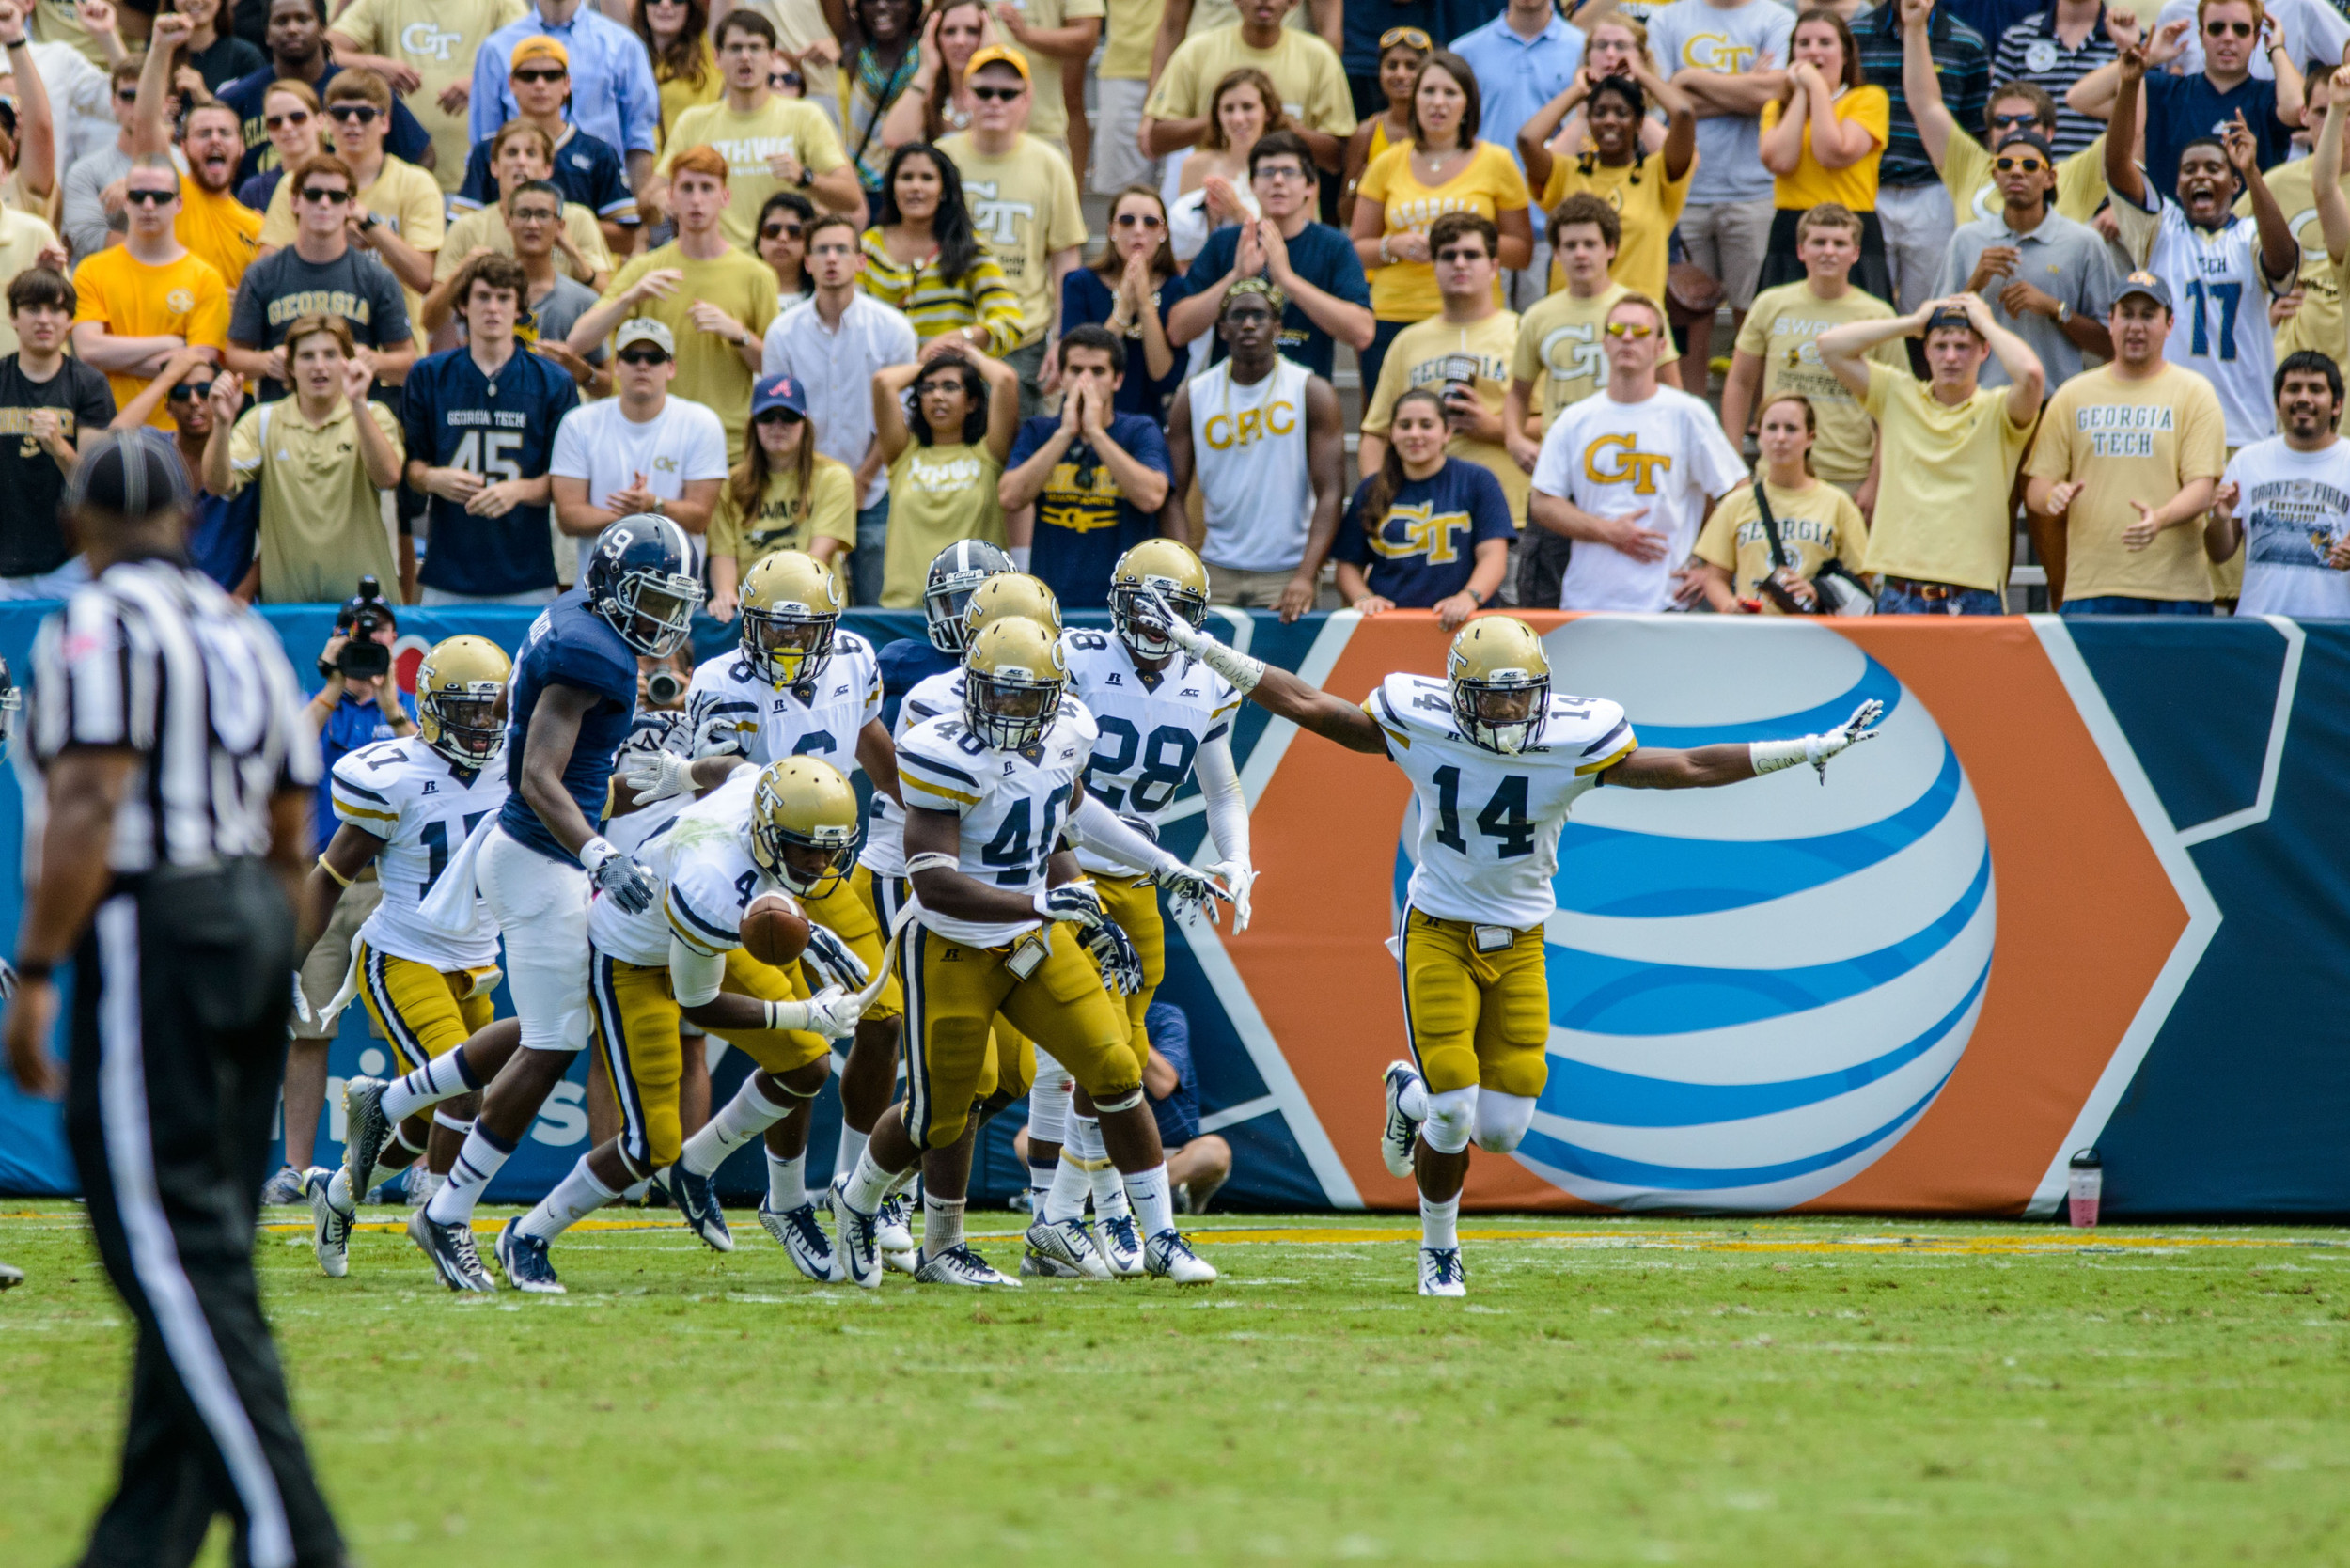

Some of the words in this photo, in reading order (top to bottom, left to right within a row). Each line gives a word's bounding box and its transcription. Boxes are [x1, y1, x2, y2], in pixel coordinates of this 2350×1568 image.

[400, 22, 462, 61] GT
[1682, 33, 1754, 74] GT
[267, 290, 371, 327] GEORGIA
[2186, 279, 2243, 362] 17
[768, 378, 793, 398] A
[447, 409, 493, 427] GEORGIA
[494, 411, 527, 429] TECH
[2076, 405, 2174, 431] GEORGIA
[448, 430, 523, 489] 45
[2092, 432, 2154, 458] TECH
[1584, 433, 1671, 495] GT
[2250, 480, 2292, 506] GRANT
[2313, 482, 2349, 514] FIELD
[604, 528, 634, 559] 9
[1368, 498, 1473, 566] GT
[1736, 517, 1835, 550] GERGIA
[954, 571, 975, 580] GATA
[1154, 578, 1172, 587] ACC
[479, 682, 495, 691] ACC
[1005, 669, 1025, 678] ACC
[1209, 654, 1257, 689] GUMP
[1178, 688, 1200, 698] ACC
[1412, 680, 1452, 712] 14
[1551, 696, 1598, 720] 14
[934, 720, 987, 757] 40
[356, 743, 410, 772] 17
[1079, 714, 1198, 812] 28
[1433, 764, 1536, 859] 14
[981, 782, 1072, 886] 40
